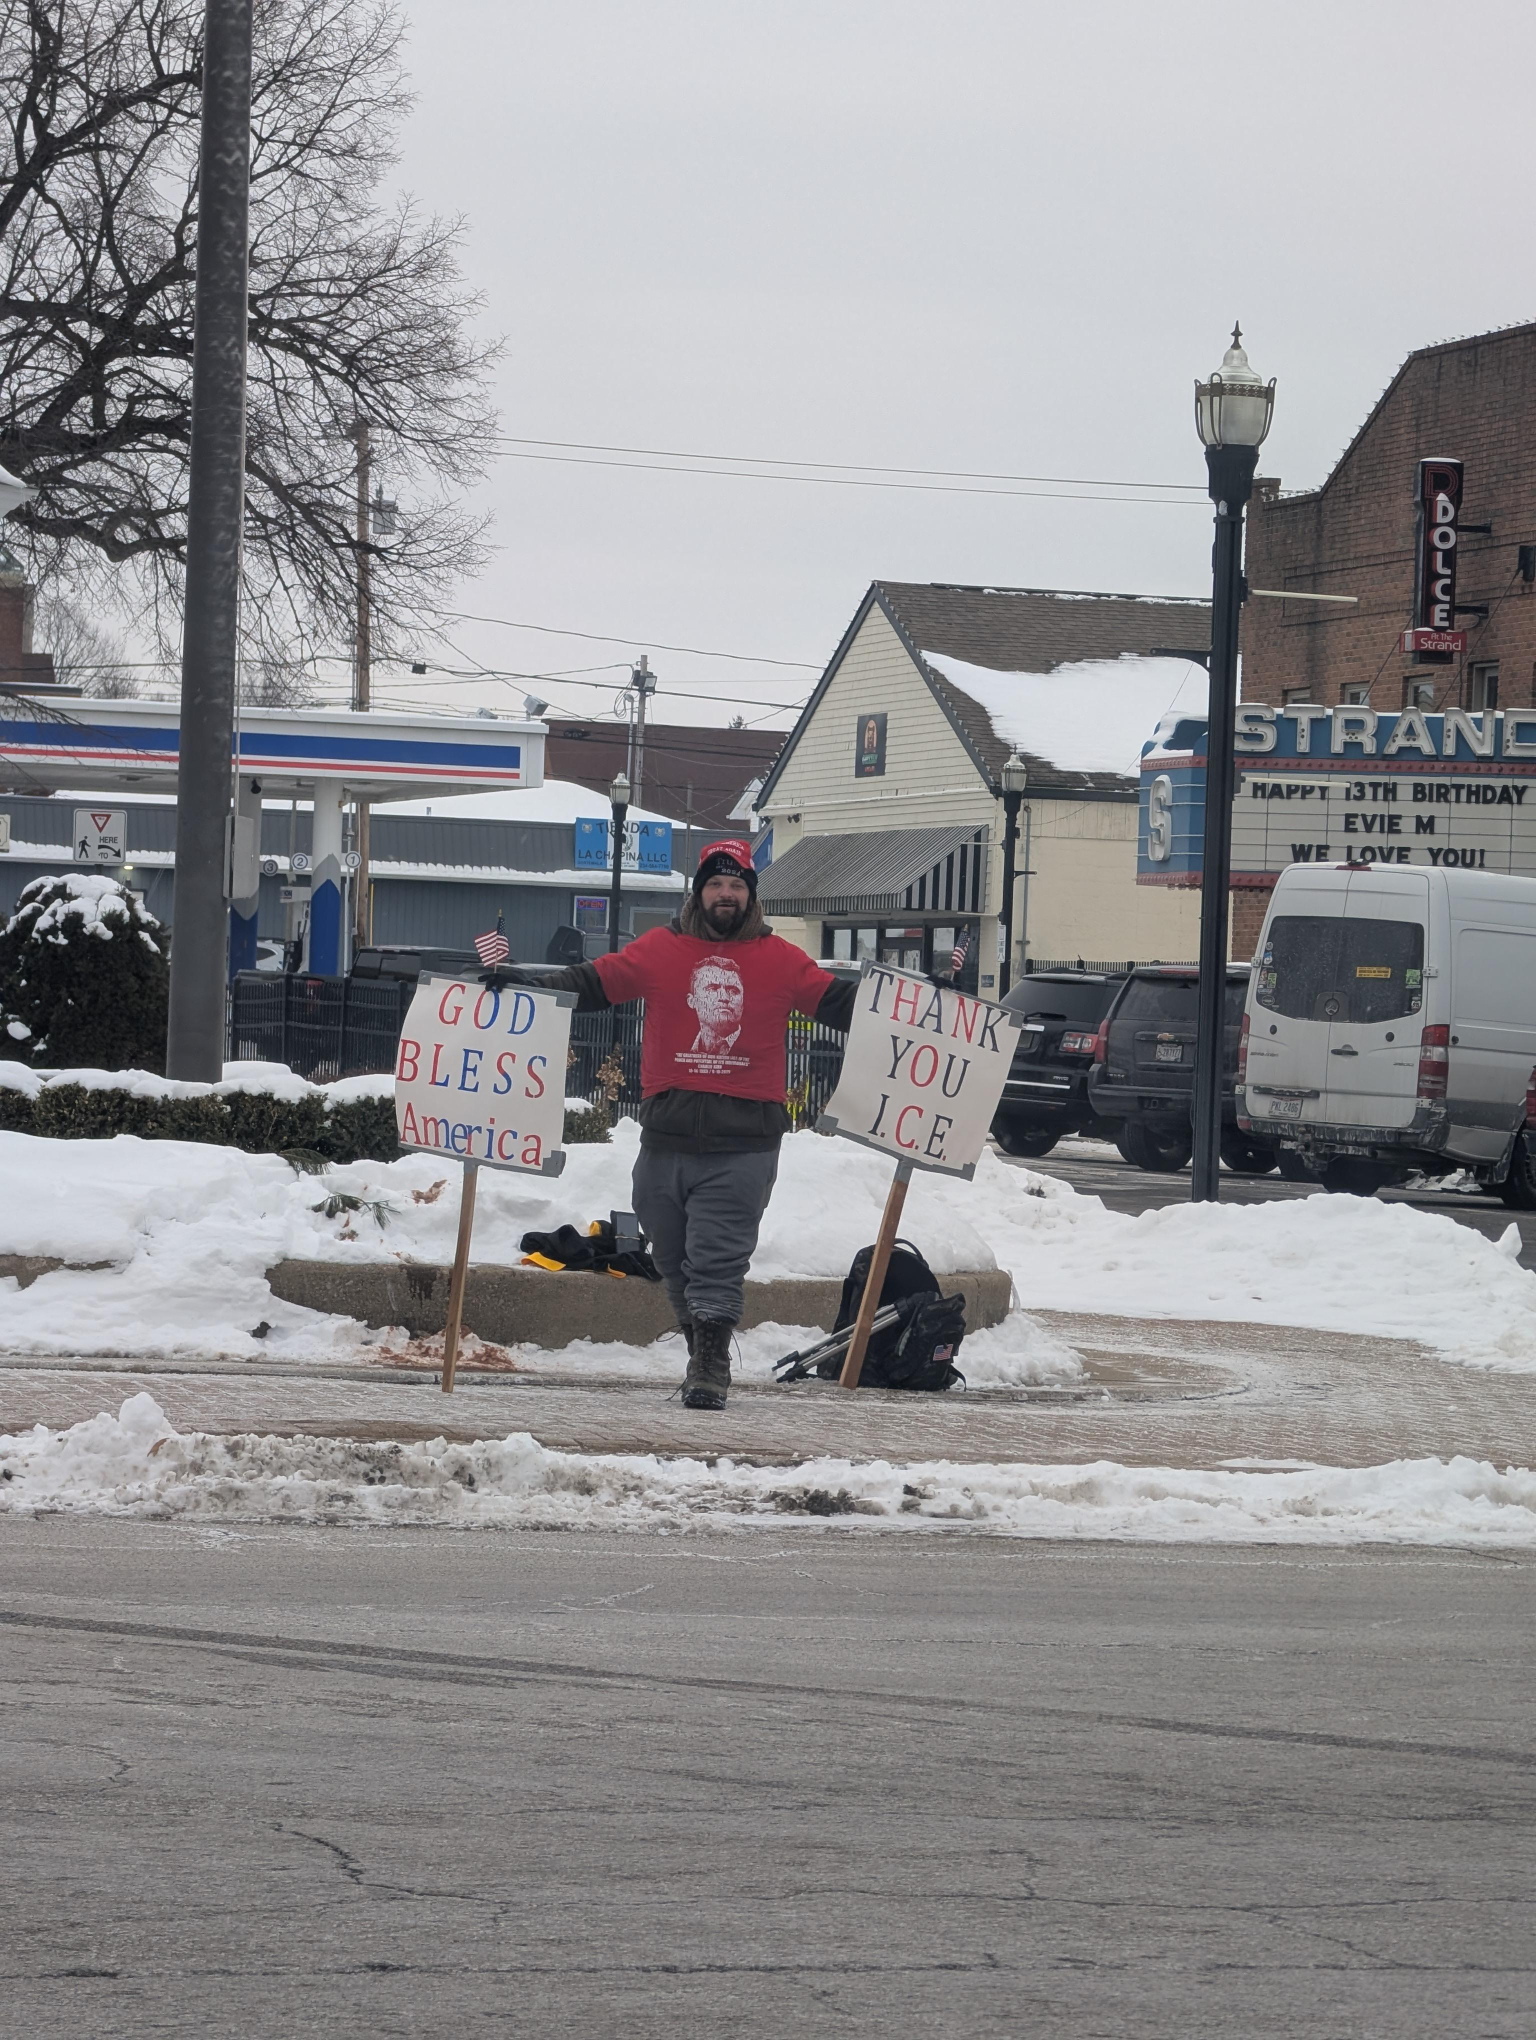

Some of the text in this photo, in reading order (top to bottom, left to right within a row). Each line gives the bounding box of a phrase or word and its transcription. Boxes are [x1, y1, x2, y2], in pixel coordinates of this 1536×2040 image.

[1430, 500, 1456, 627] DOLCE
[1421, 638, 1461, 651] Strand
[1441, 633, 1453, 641] The
[1252, 782, 1529, 805] HAPPY 13TH BIRTHDAY
[1343, 813, 1435, 835] EVIE M
[99, 836, 118, 844] HERE
[98, 852, 109, 860] TO
[266, 862, 274, 872] 3
[296, 857, 304, 867] 2
[578, 849, 592, 859] LA
[647, 853, 668, 863] LLC
[1291, 844, 1330, 864] WE
[1427, 847, 1486, 868] YOU!
[438, 983, 536, 1035] GOD
[868, 968, 1010, 1053] THANK
[396, 1039, 547, 1099] BLESS
[887, 1034, 971, 1098] YOU
[400, 1102, 542, 1167] America
[867, 1093, 954, 1162] I.C.E.
